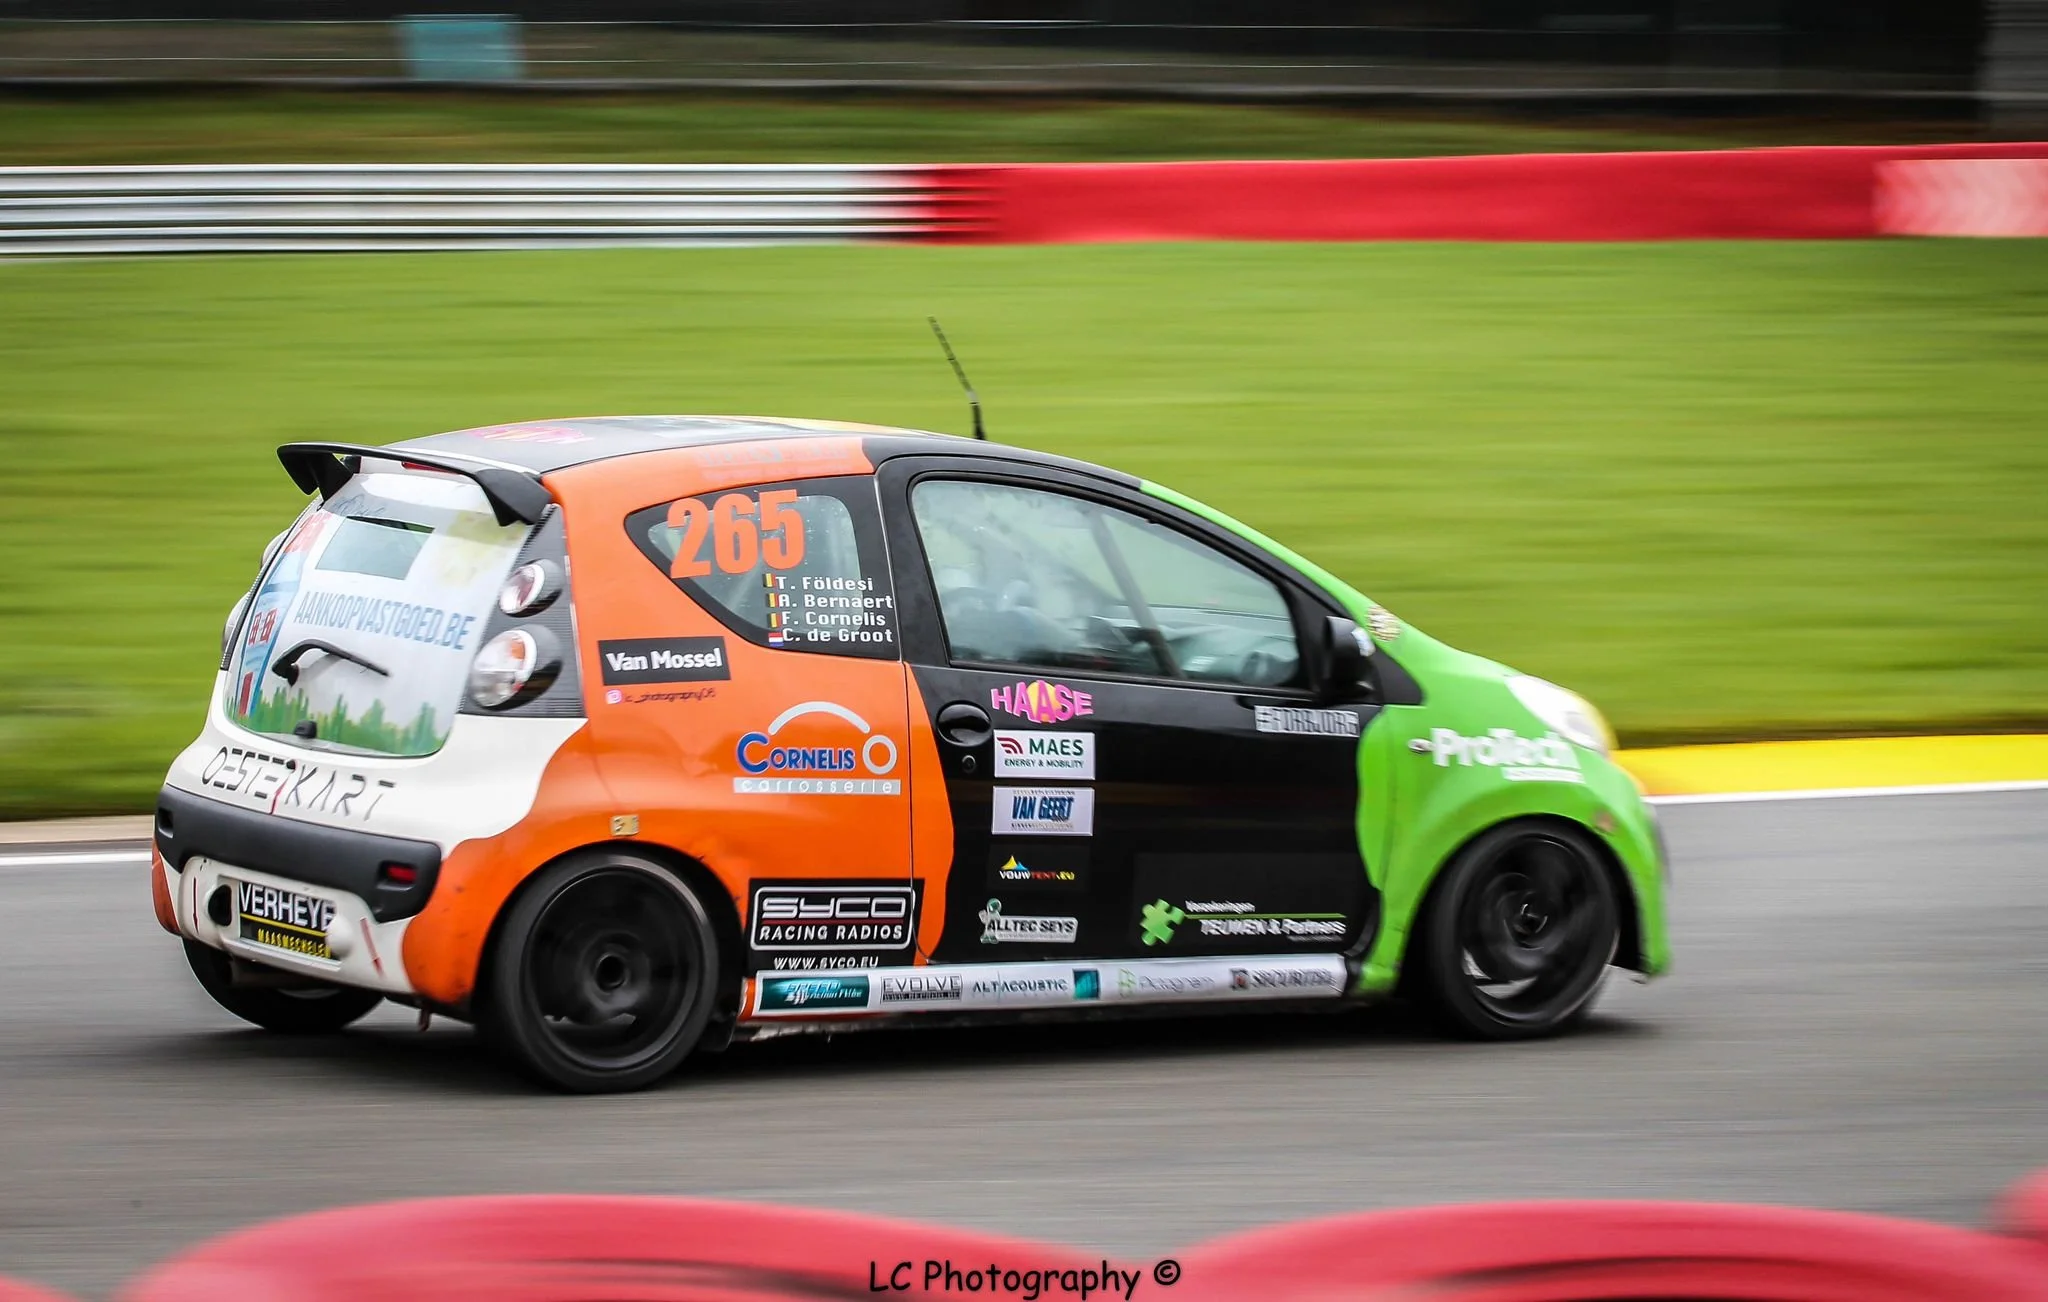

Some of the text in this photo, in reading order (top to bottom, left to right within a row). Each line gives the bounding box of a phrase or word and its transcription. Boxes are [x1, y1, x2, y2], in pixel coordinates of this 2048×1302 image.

[667, 489, 806, 578] 265
[775, 576, 873, 591] T. Földesi
[778, 594, 893, 609] A. Bernaert
[293, 591, 476, 650] AANKOOPVASTGOED.BE
[781, 611, 886, 626] F. Cornelis
[782, 628, 893, 642] C. de Groot
[606, 648, 723, 671] Van Mossel
[990, 680, 1094, 724] HAASE
[1029, 738, 1084, 756] MAES
[1004, 759, 1084, 769] ENERGY & MOBILITY
[740, 779, 893, 794] carrosserie
[1012, 796, 1037, 820] VAN
[762, 897, 906, 919] SYCO
[760, 925, 903, 941] RACING RADIOS
[987, 919, 1075, 934] ALLTEC SEYS
[774, 956, 879, 970] WWW.SYCO.EU
[883, 975, 961, 993] EVOLVE
